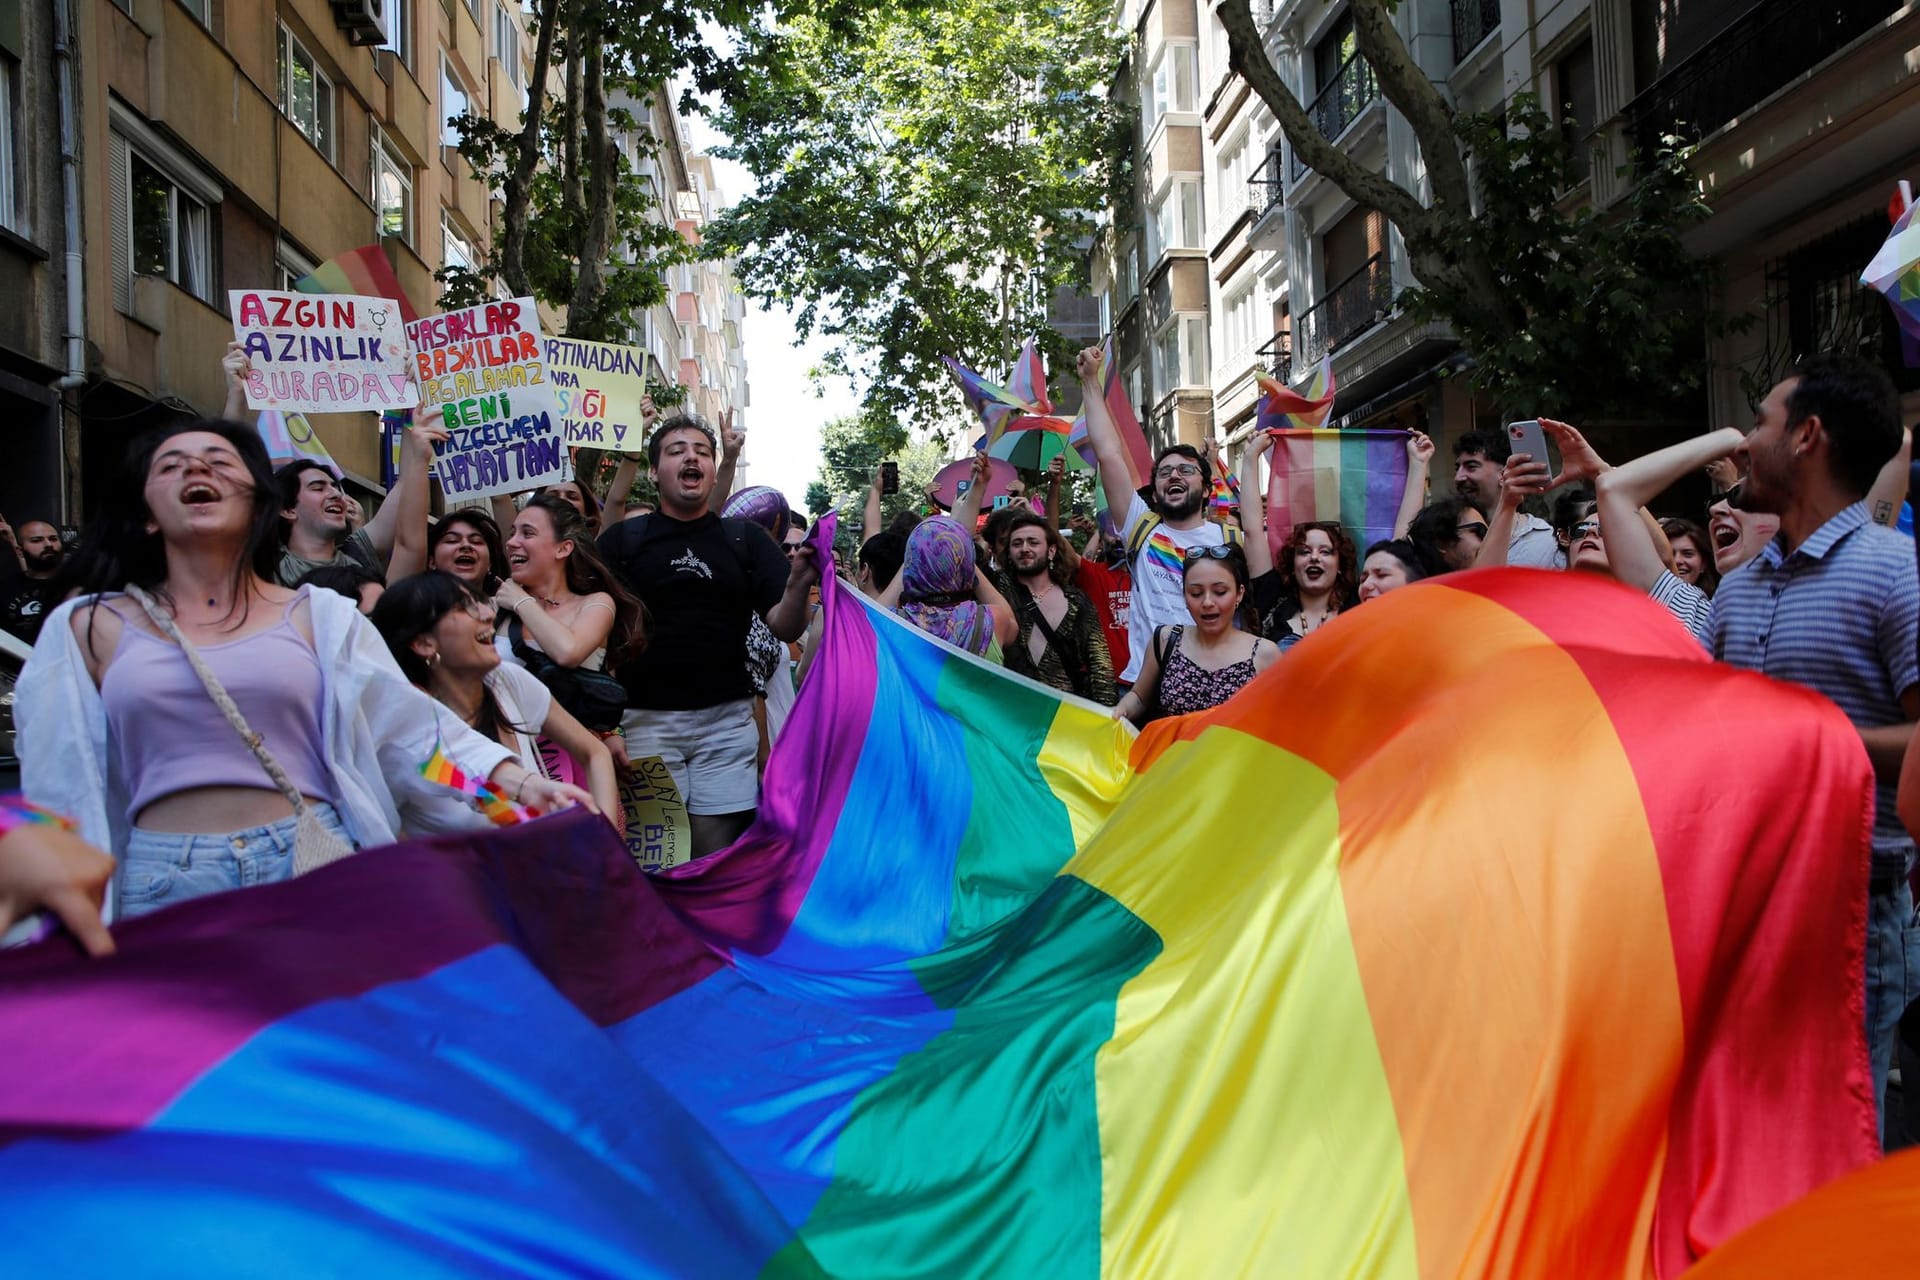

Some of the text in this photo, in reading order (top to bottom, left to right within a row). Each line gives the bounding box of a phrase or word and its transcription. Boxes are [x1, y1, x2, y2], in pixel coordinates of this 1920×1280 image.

[240, 293, 355, 329] AZGIN
[407, 302, 521, 352] YASAKLAR
[243, 332, 384, 362] AZINLIK
[416, 331, 539, 381] BASKILAR
[442, 392, 511, 429] BENİ
[437, 436, 561, 495] HAYATTAN
